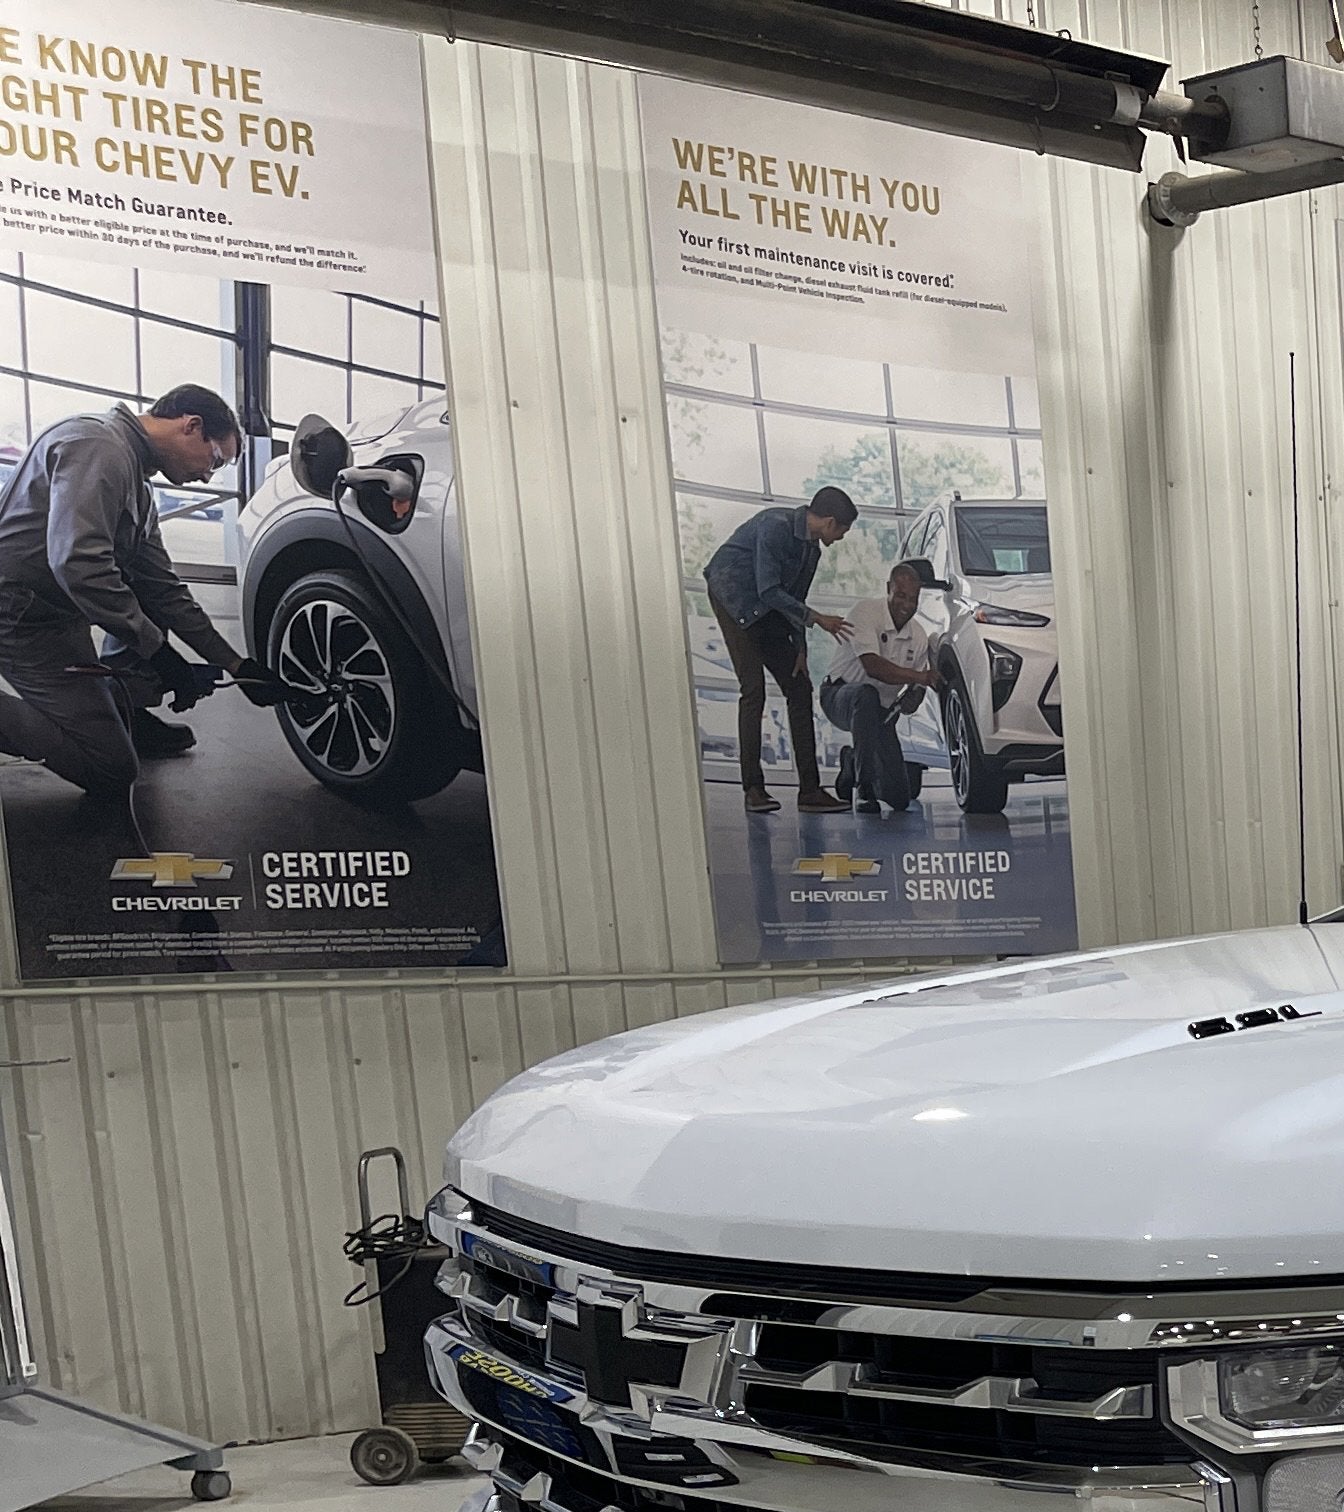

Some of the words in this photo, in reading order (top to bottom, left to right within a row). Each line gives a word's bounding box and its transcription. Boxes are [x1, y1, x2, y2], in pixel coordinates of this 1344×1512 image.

[37, 37, 168, 88] KNOW
[181, 60, 263, 104] THE
[102, 93, 224, 143] TIRES
[238, 114, 314, 156] FOR
[94, 139, 234, 187] CHEVY
[249, 160, 309, 200] EV.
[671, 140, 778, 187] WE'RE
[787, 162, 870, 204] WITH
[879, 179, 940, 216] YOU
[10, 179, 61, 201] Price
[67, 189, 125, 210] Match
[132, 198, 232, 224] Guarantee.
[676, 180, 740, 221] ALL
[748, 194, 812, 234] THE
[820, 208, 896, 247] WAY.
[3, 218, 35, 230] better
[38, 225, 65, 235] price
[67, 230, 99, 239] within
[102, 232, 114, 242] 30
[117, 236, 140, 246] days
[142, 239, 152, 247] of
[154, 240, 170, 250] the
[173, 244, 220, 256] purchase,
[222, 250, 240, 258] and
[265, 254, 296, 265] refund
[298, 258, 314, 268] the
[10, 208, 22, 216] us
[24, 210, 47, 219] with
[59, 214, 91, 225] better
[94, 220, 129, 231] eligible
[132, 226, 157, 235] price
[160, 229, 170, 237] at
[172, 230, 188, 240] the
[190, 233, 212, 242] time
[214, 235, 224, 244] of
[226, 239, 273, 251] purchase,
[275, 244, 292, 252] and
[317, 249, 346, 258] match
[678, 230, 713, 248] Your
[717, 237, 750, 256] first
[754, 248, 845, 272] maintenance
[848, 262, 878, 277] visit
[882, 265, 893, 280] is
[262, 851, 411, 878] CERTIFIED
[902, 851, 1010, 875] CERTIFIED
[112, 896, 243, 912] CHEVROLET
[265, 882, 389, 910] SERVICE
[790, 890, 888, 903] CHEVROLET
[905, 878, 995, 901] SERVICE
